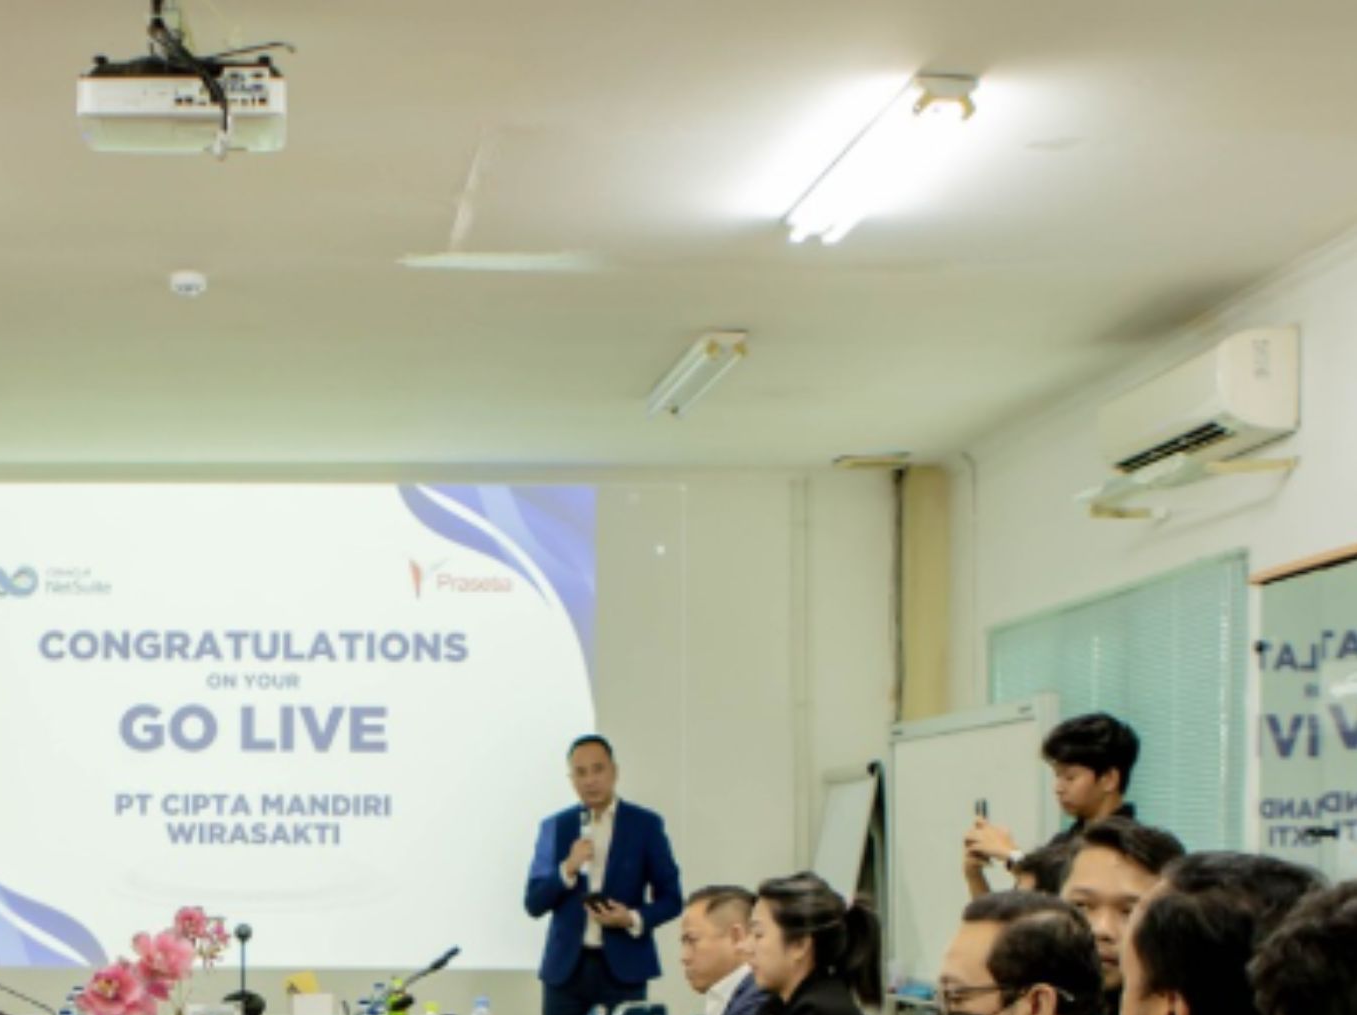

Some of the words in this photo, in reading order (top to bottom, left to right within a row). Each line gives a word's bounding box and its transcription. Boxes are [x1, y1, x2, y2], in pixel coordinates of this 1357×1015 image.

[38, 629, 469, 664] CONGRATULATIONS
[205, 671, 238, 690] ON
[244, 671, 301, 690] YOUR
[118, 702, 219, 754] GO
[240, 704, 389, 754] LIVE
[114, 793, 152, 817] PT
[160, 793, 252, 817] CIPTA
[260, 793, 393, 818] MANDIRI
[165, 821, 341, 847] WIRASAKTI
